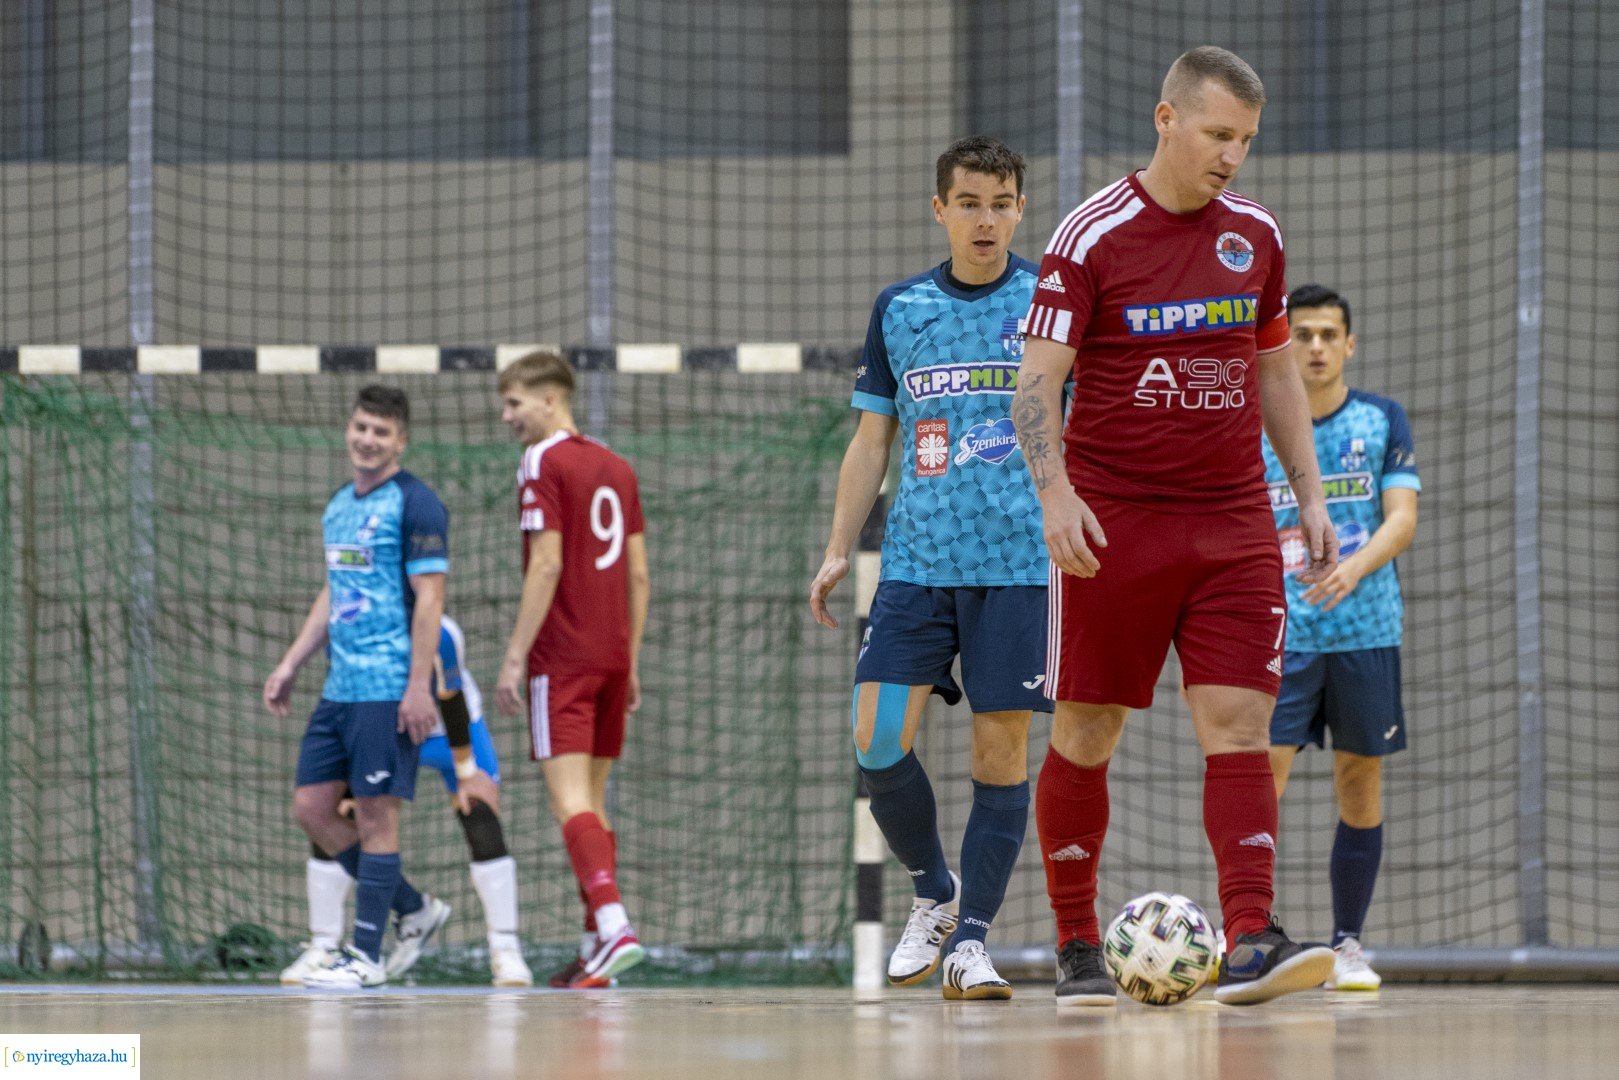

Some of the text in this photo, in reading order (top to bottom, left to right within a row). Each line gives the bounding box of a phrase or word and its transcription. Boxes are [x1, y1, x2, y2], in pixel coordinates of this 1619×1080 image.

[1039, 282, 1066, 293] adidas
[1133, 389, 1246, 410] STUDIO
[918, 422, 946, 433] caritas
[918, 468, 946, 477] hungarica
[590, 486, 625, 570] 9
[1271, 607, 1286, 650] 7
